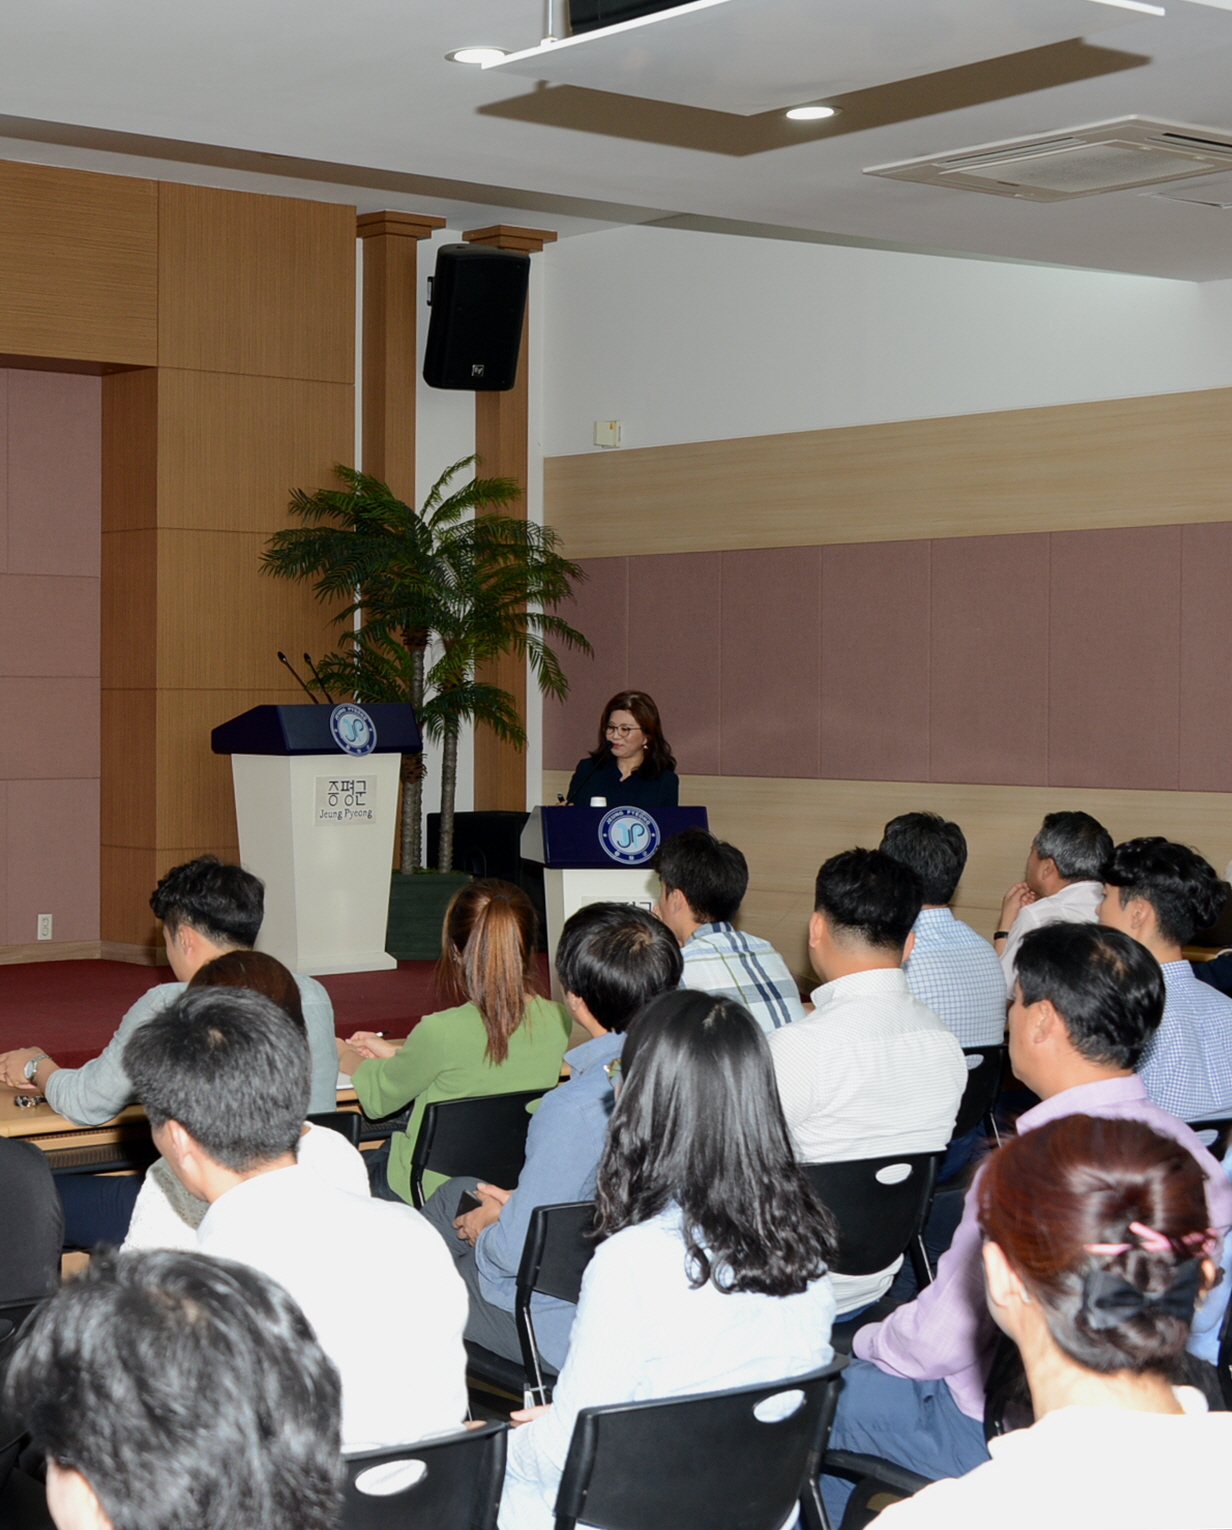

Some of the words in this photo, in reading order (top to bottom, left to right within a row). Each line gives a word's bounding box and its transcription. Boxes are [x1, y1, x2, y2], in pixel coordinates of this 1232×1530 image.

[328, 780, 366, 806] 증평군
[319, 809, 343, 820] Jeung
[344, 808, 373, 820] Pyeong
